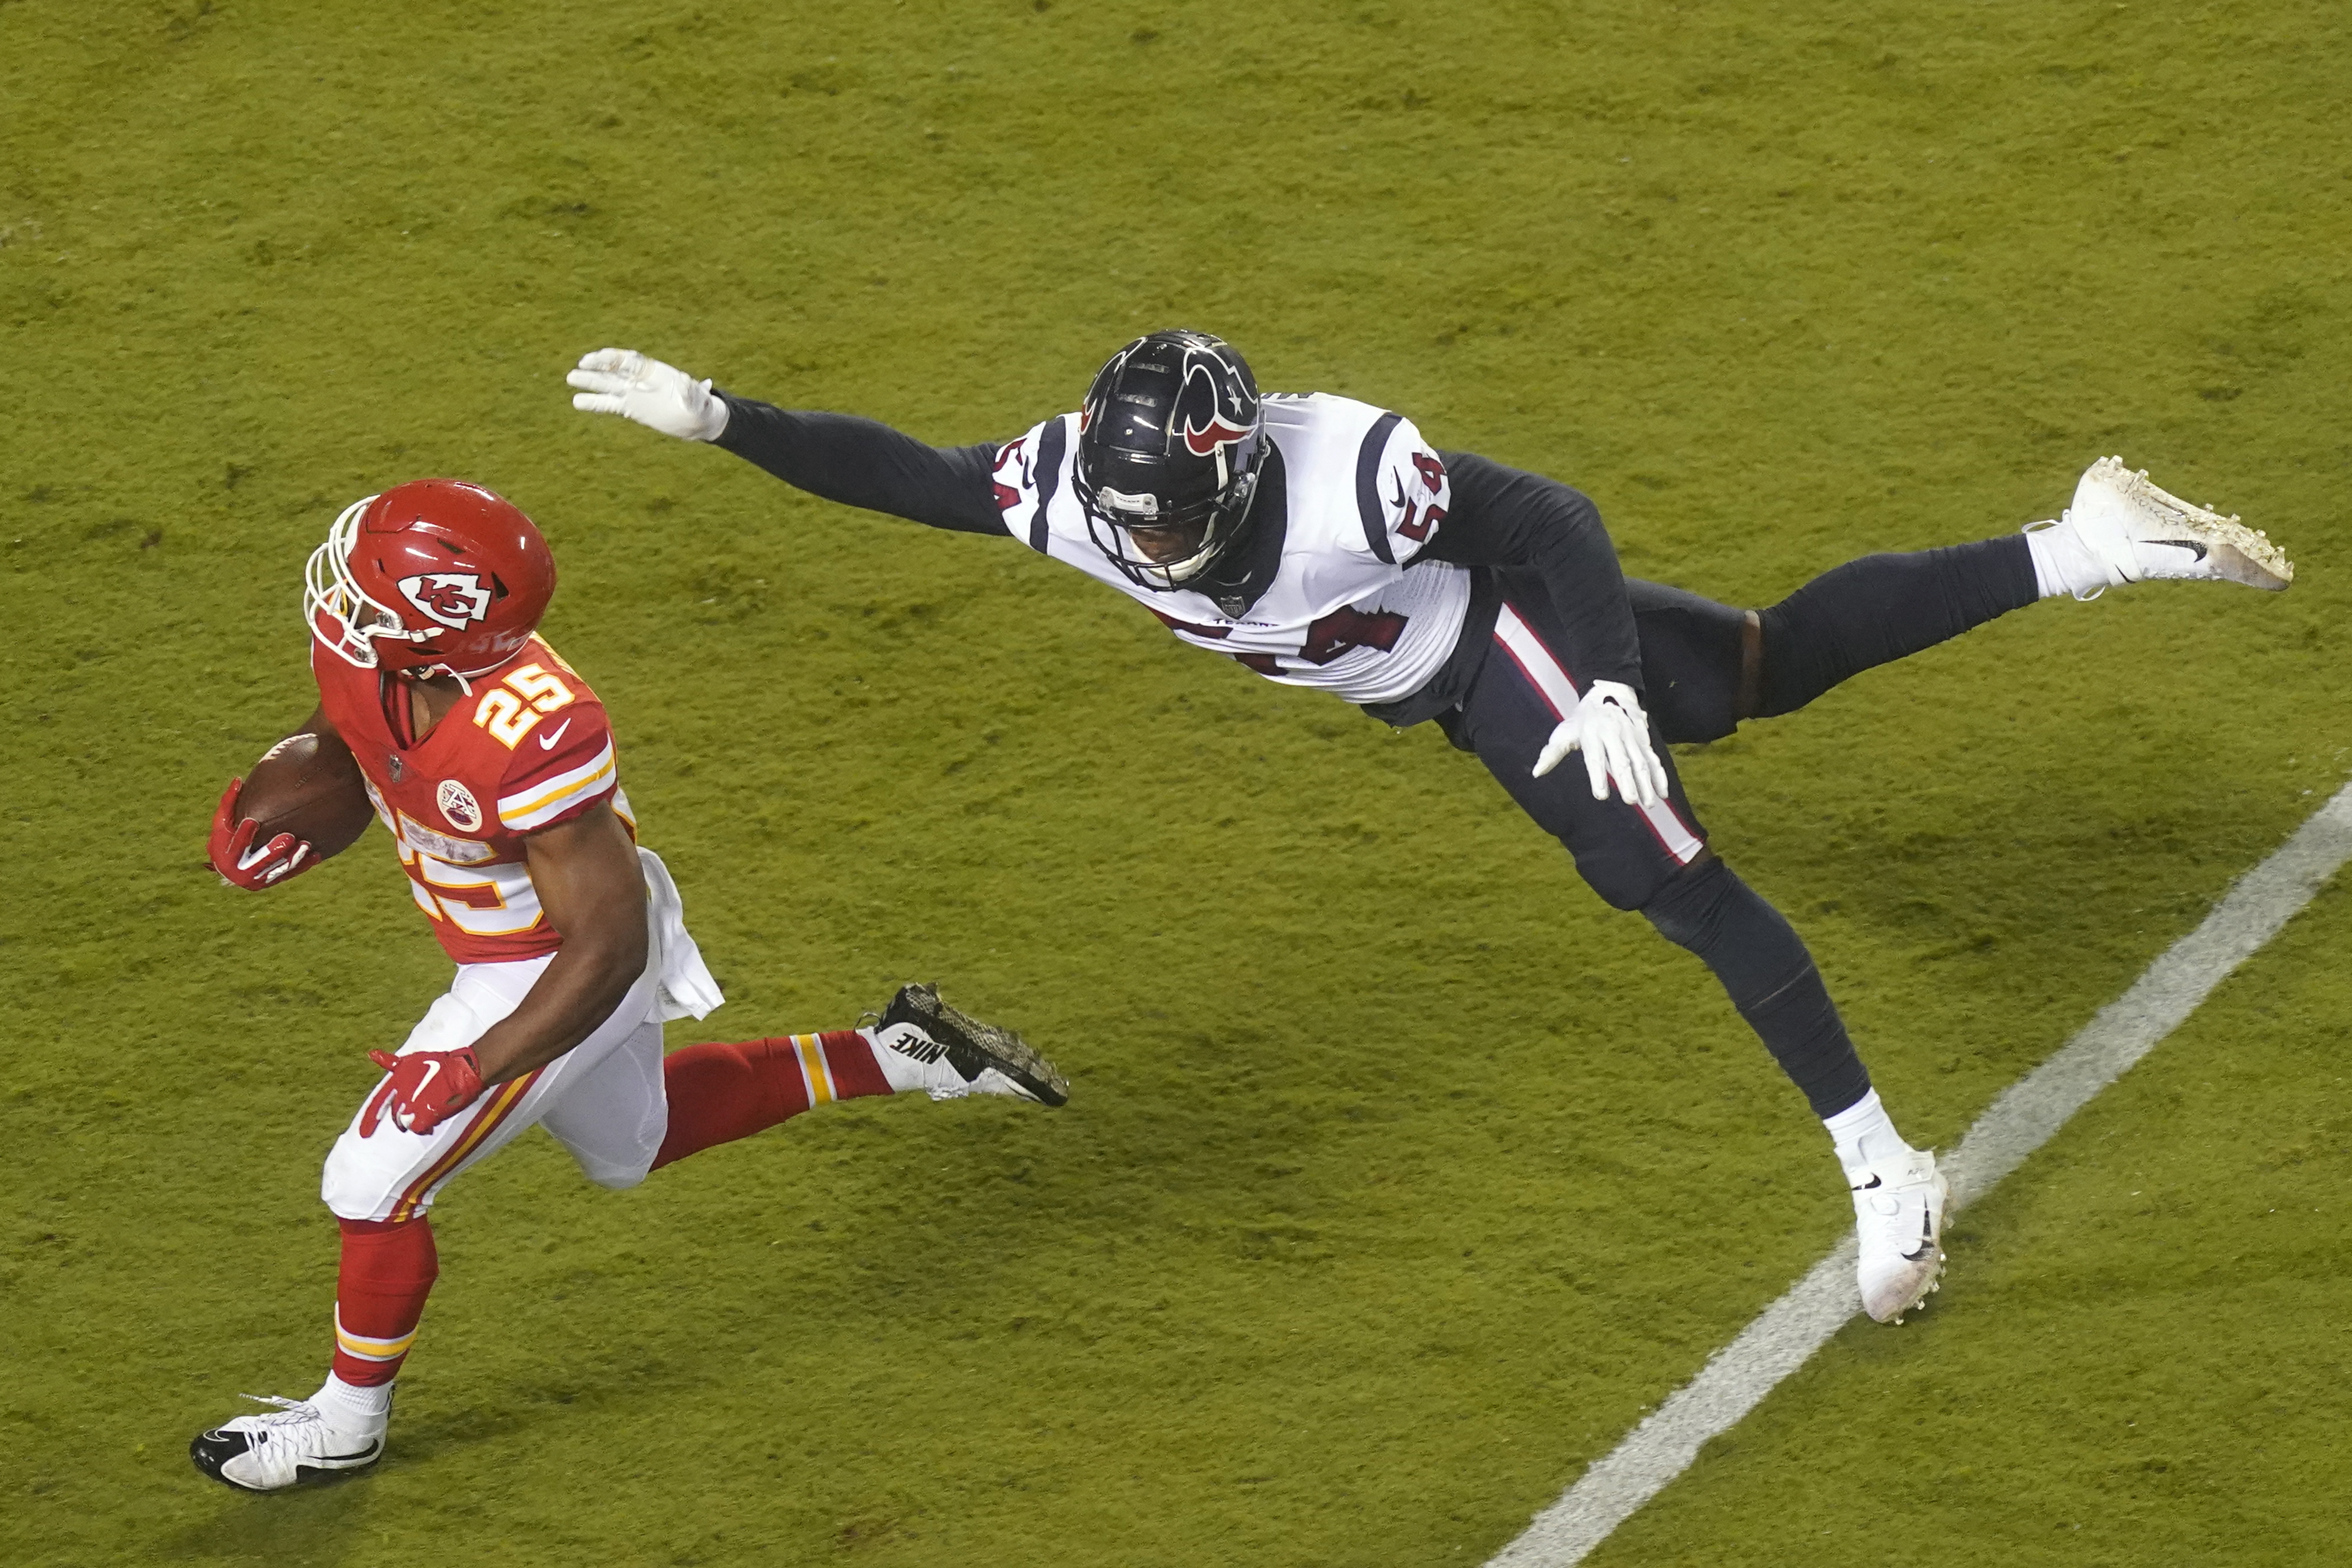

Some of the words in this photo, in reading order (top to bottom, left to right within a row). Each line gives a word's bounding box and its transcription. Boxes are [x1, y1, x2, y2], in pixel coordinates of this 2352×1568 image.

[1396, 452, 1448, 543] 54
[415, 576, 477, 619] KC
[472, 662, 575, 750] 25
[889, 1032, 947, 1065] NIKE
